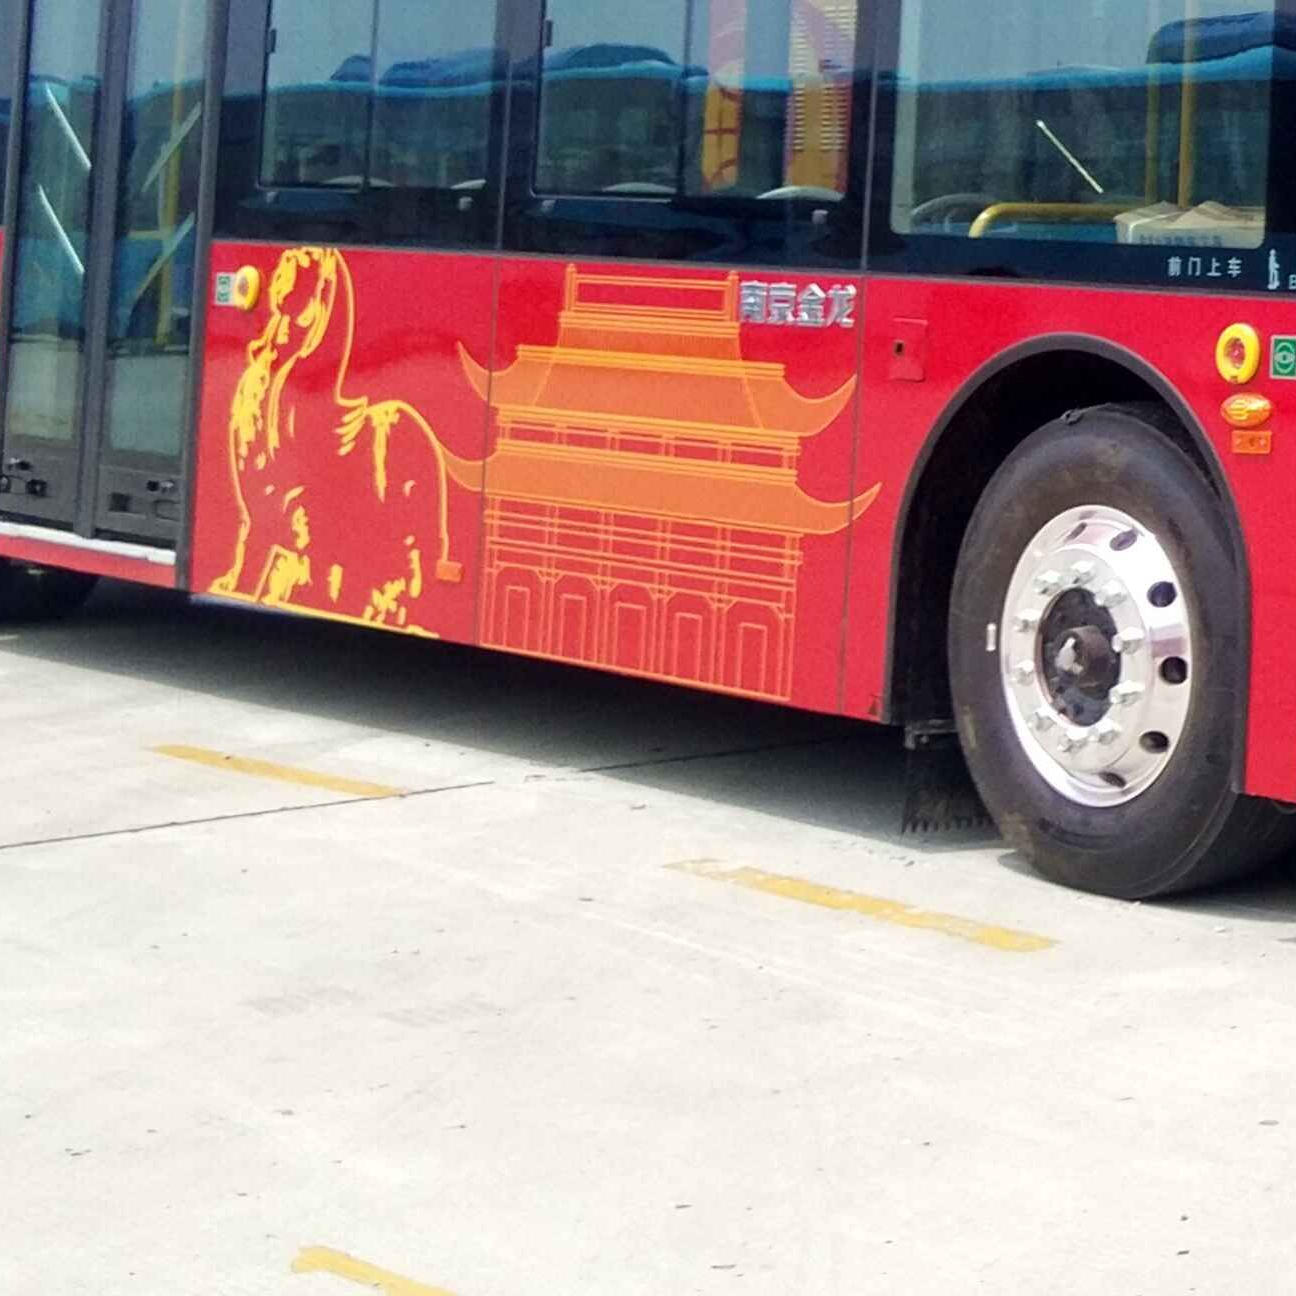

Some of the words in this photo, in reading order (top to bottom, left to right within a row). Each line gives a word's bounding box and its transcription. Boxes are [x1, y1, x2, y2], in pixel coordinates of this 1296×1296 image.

[1167, 256, 1243, 278] 前门上车
[740, 280, 857, 328] 南京金龙
